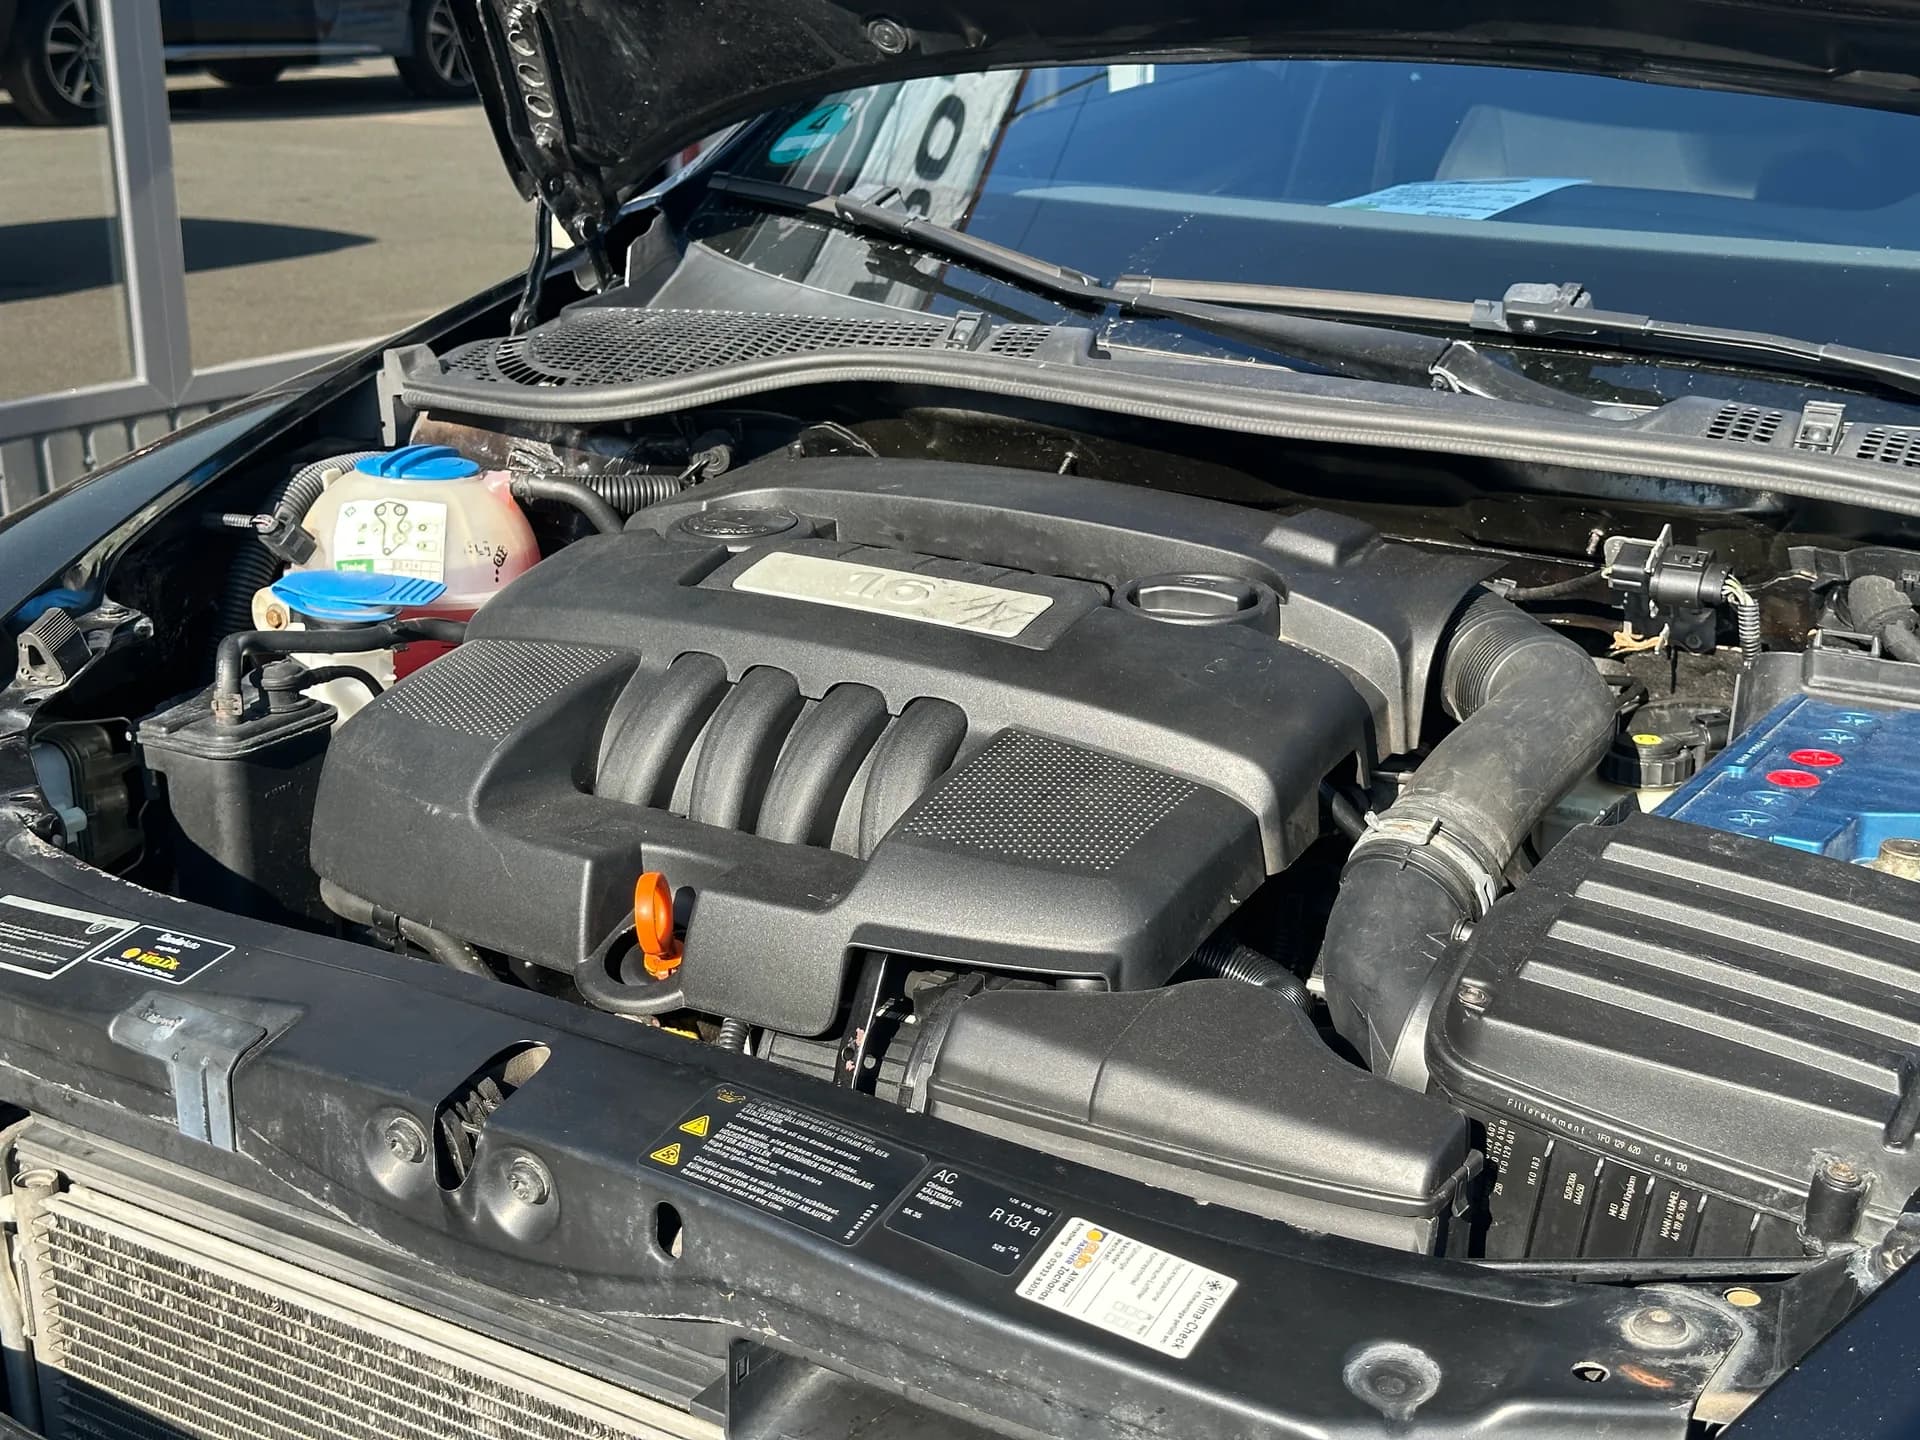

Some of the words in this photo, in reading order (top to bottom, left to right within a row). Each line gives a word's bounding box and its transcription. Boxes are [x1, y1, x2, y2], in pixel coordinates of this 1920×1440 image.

[1496, 1126, 1506, 1141] 610
[1505, 1130, 1516, 1145] 601
[1493, 1141, 1503, 1155] 129
[1502, 1145, 1513, 1159] 129
[1627, 1144, 1641, 1155] 620
[1654, 1154, 1660, 1162] C
[1498, 1160, 1509, 1174] 1F0
[1530, 1156, 1541, 1170] 183
[932, 1169, 958, 1184] AC
[1526, 1171, 1537, 1186] 1K0
[989, 1207, 1005, 1221] R
[1004, 1213, 1031, 1231] 134
[1029, 1226, 1040, 1236] a
[1065, 1239, 1088, 1264] PARTNER
[1038, 1266, 1069, 1300] Zacharias
[1058, 1270, 1079, 1293] Alfred
[1172, 1295, 1216, 1349] Klima-Check
